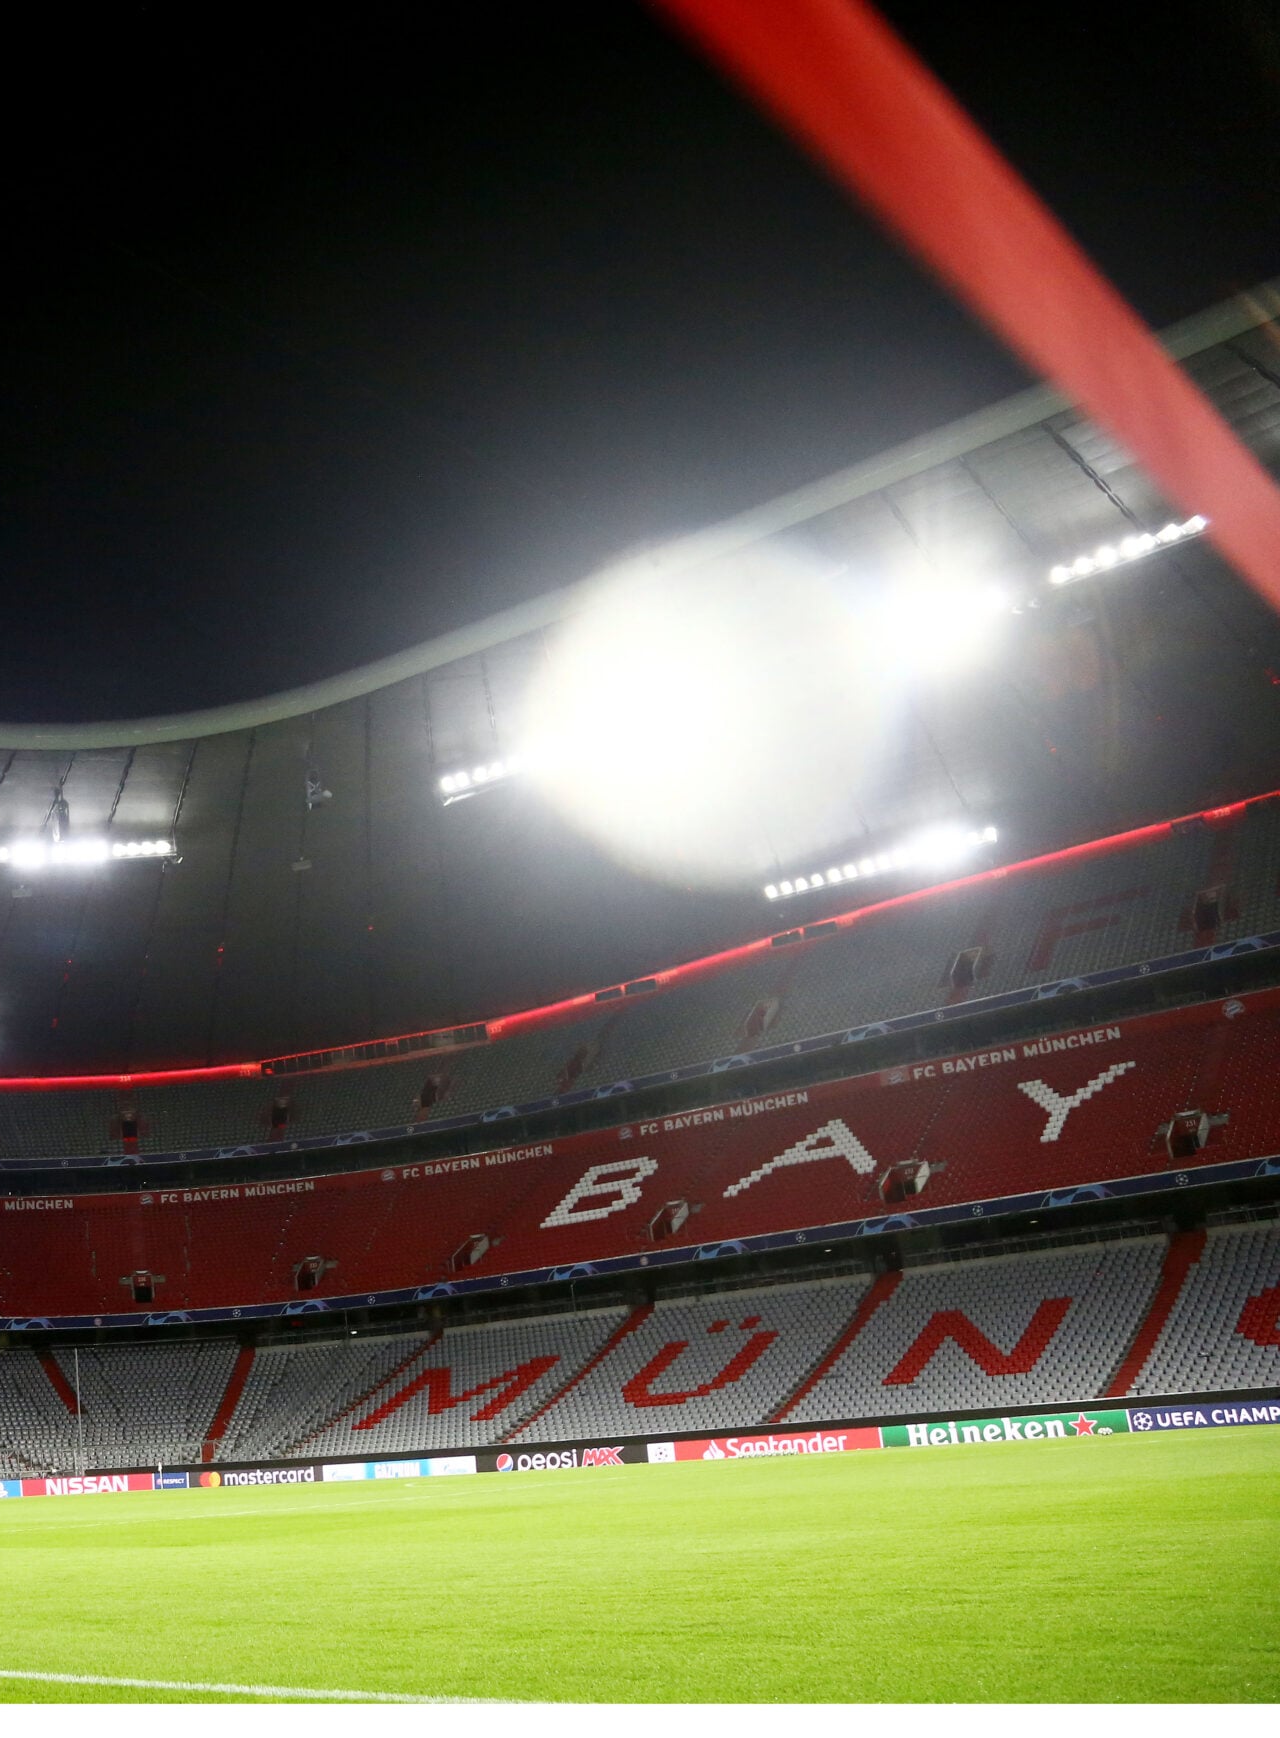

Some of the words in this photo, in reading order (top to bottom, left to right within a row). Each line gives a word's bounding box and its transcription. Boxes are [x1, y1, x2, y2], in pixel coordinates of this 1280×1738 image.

[912, 1065, 937, 1080] FC
[942, 1048, 1017, 1075] BAYERN
[1022, 1026, 1121, 1058] MÜNCHEN
[639, 1123, 659, 1136] FC
[664, 1109, 725, 1131] BAYERN
[729, 1091, 809, 1118] MÜNCHEN
[402, 1168, 420, 1180] FC
[424, 1157, 481, 1176] BAYERN
[485, 1144, 553, 1166] MÜNCHEN
[4, 1198, 74, 1211] MÜNCHEN
[160, 1194, 178, 1204] FC
[183, 1188, 240, 1203] BAYERN
[244, 1181, 315, 1197] MÜNCHEN
[1156, 1410, 1208, 1428] UEFA
[1212, 1406, 1280, 1424] CHAMP
[907, 1416, 1067, 1447] Heineken
[727, 1433, 848, 1459] Santander
[517, 1448, 578, 1472] pepsi
[581, 1446, 625, 1468] MAX
[45, 1475, 128, 1496] NISSAN
[162, 1477, 185, 1485] RESPECT
[224, 1466, 314, 1486] mastercard
